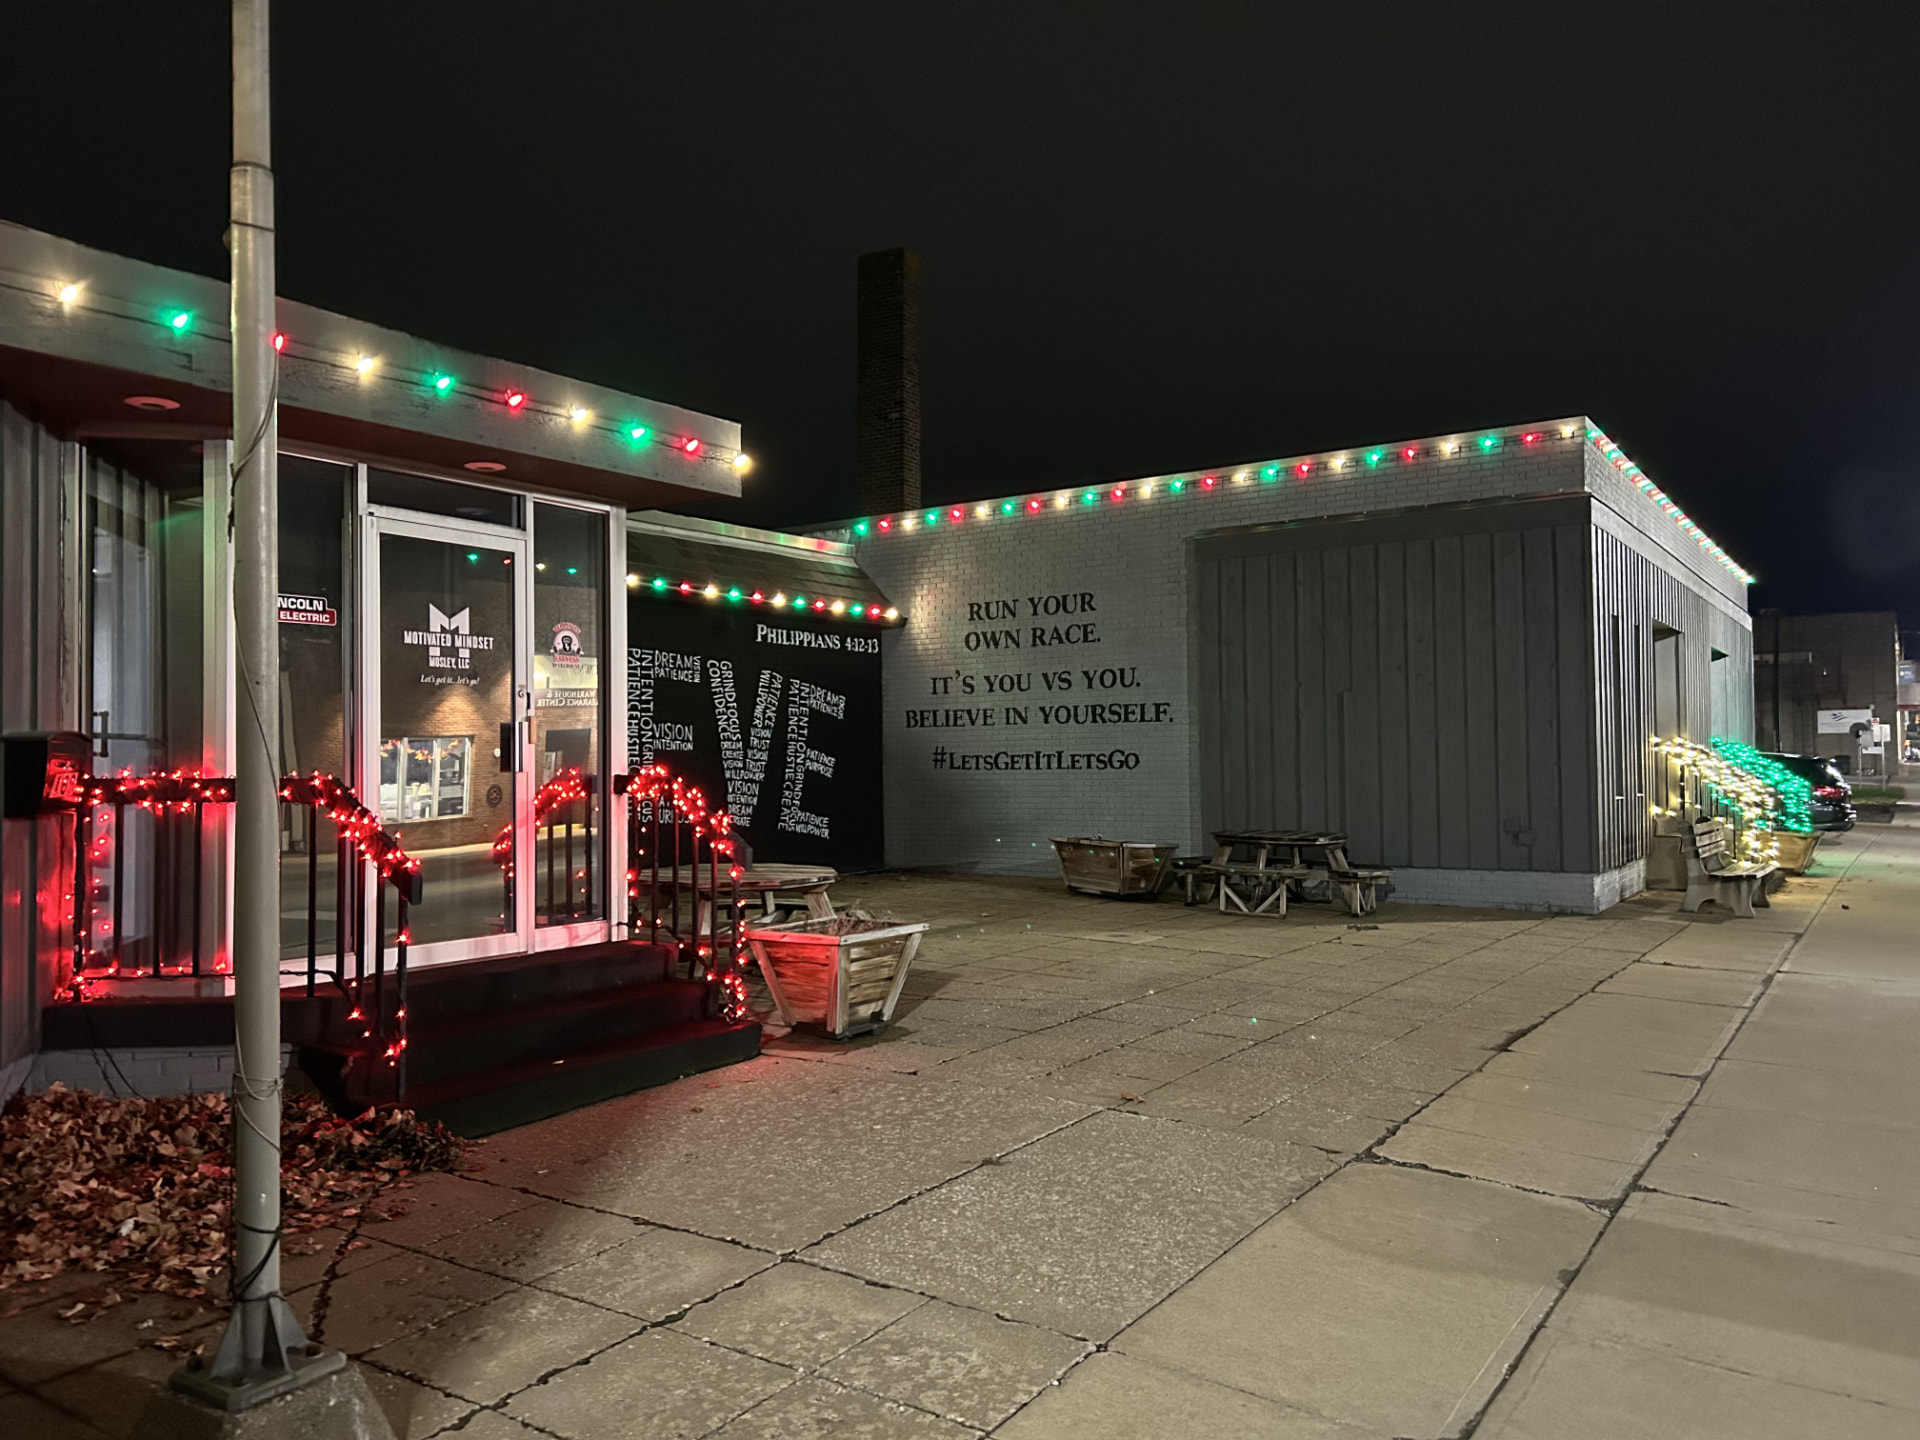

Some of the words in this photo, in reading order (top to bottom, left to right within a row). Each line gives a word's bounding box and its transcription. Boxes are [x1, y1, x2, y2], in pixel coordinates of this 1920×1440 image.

[278, 597, 324, 611] NCOLN
[968, 599, 1019, 621] RUN
[1028, 592, 1097, 616] YOUR
[280, 611, 330, 622] ELECTRIC
[404, 630, 452, 647] MOTIVATED
[455, 634, 494, 650] MINDSET
[756, 624, 840, 649] PHILIPPIANS
[845, 637, 879, 653] 4:12-13
[965, 629, 1021, 651] OWN
[1031, 624, 1101, 647] RACE.
[458, 658, 470, 669] LLC
[655, 650, 693, 668] DREAM
[655, 667, 693, 682] PATIENCE
[693, 656, 701, 683] VISION
[628, 648, 640, 718] PATIENCE
[720, 661, 736, 702] GRIND
[931, 670, 975, 695] IT'S
[984, 673, 1032, 693] YOU
[1042, 671, 1072, 690] VS
[1081, 667, 1141, 689] YOU.
[641, 649, 654, 742] INTENTION
[706, 660, 732, 740] CONFIDENCE
[752, 669, 771, 727] WILLPOWER
[764, 672, 783, 728] PATIENCE
[810, 684, 840, 705] DREAM
[787, 679, 800, 741] PATIENCE
[809, 697, 839, 717] PATIENCE
[905, 708, 995, 728] BELIEVE
[1004, 706, 1029, 725] IN
[1039, 703, 1174, 724] YOURSELF.
[653, 722, 693, 741] VISION
[727, 702, 742, 741] FOCUS
[796, 682, 810, 764] INTENTION
[750, 727, 772, 739] VISION
[750, 736, 770, 750] TRUST
[653, 739, 693, 751] INTENTION
[720, 741, 743, 750] DREAM
[722, 750, 744, 760] CREATE
[747, 748, 769, 761] VISION
[722, 760, 743, 768] VISION
[746, 759, 767, 772] TRUST
[785, 741, 797, 780] HUSTLE
[806, 748, 836, 767] PATIENCE
[725, 769, 765, 781] WILLPOWER
[794, 764, 805, 799] GRIND
[727, 780, 759, 795] VISION
[728, 804, 753, 816] DREAM
[778, 781, 794, 830] CREATE
[796, 810, 830, 828] PATIENCE
[795, 823, 830, 840] WILLPOWER
